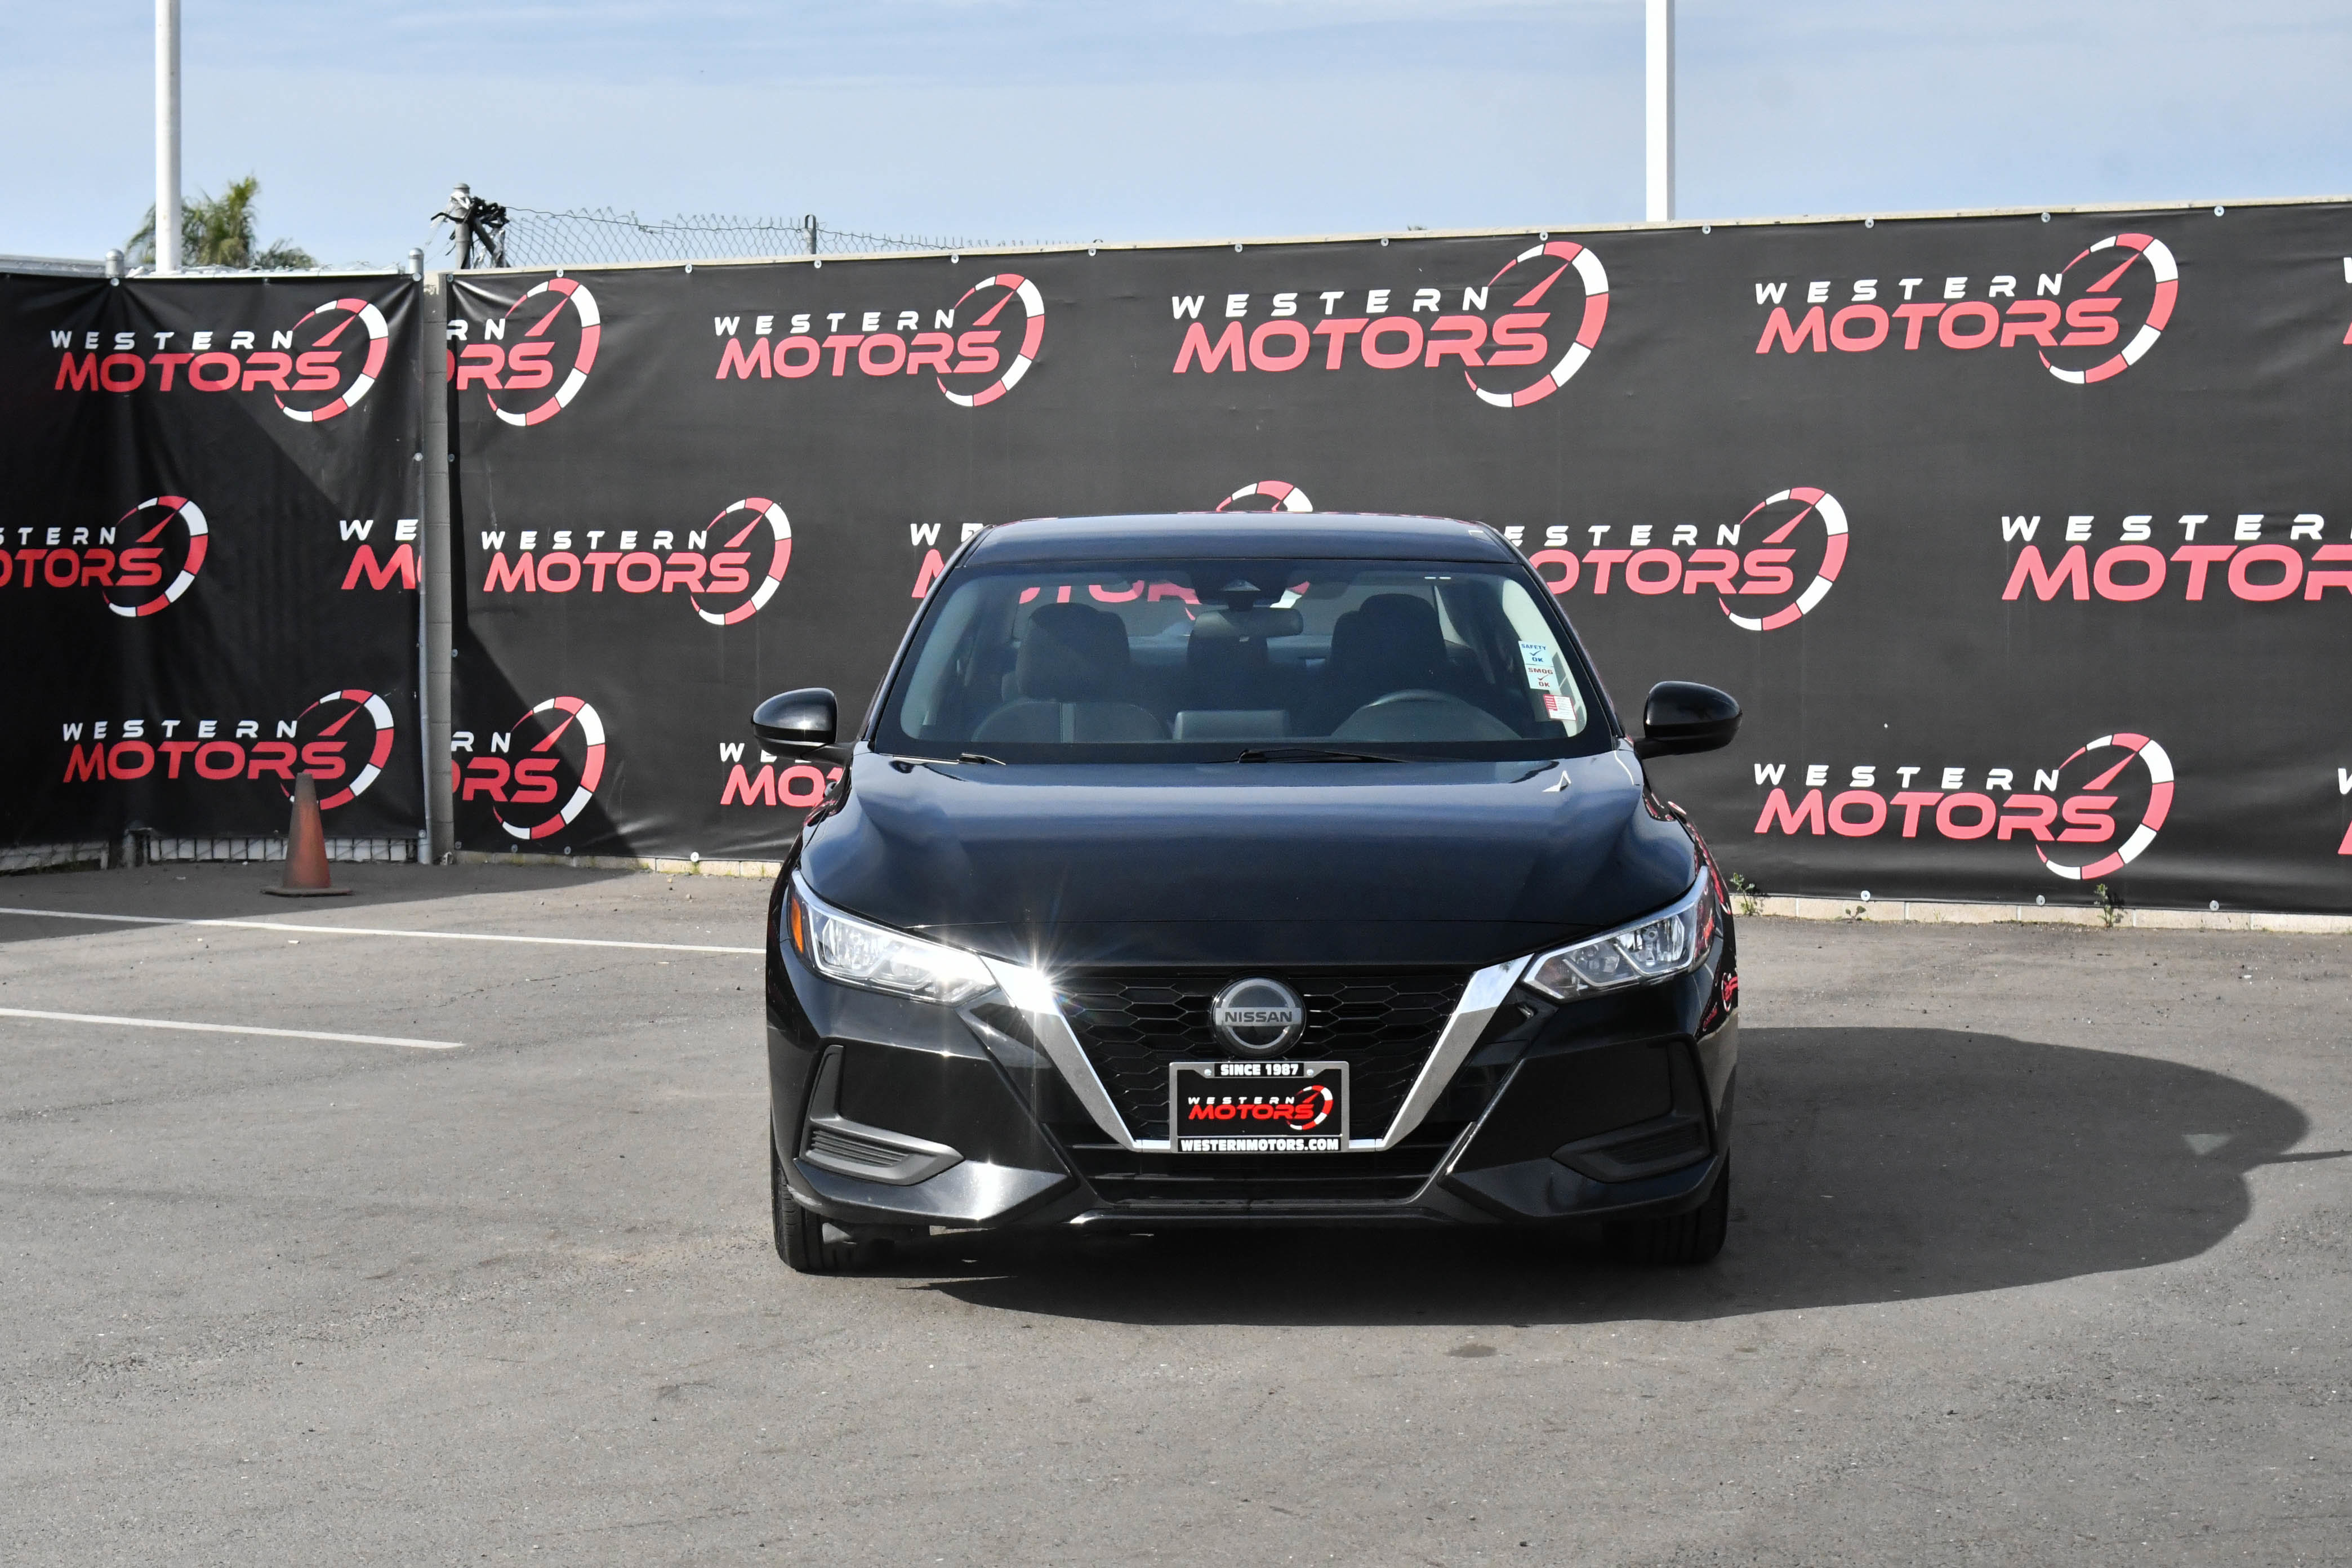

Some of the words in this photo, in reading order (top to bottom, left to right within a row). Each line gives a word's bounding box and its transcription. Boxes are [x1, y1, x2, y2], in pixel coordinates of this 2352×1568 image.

[1172, 284, 1489, 319] WESTERN
[1756, 273, 2063, 305] WESTERN
[715, 307, 955, 336] WESTERN
[1756, 297, 2122, 354] MOTORS
[52, 331, 293, 350] WESTERN
[716, 330, 1001, 380] MOTORS
[1173, 312, 1550, 373] MOTORS
[55, 351, 342, 392] MOTORS
[447, 341, 555, 390] RS
[482, 529, 707, 550] WESTERN
[2002, 514, 2352, 542] WESTER
[341, 543, 421, 590] M
[483, 551, 751, 594] MOTORS
[64, 720, 297, 741] WESTERN
[63, 740, 347, 783] MOTORS
[1754, 764, 2059, 791] WESTERN
[452, 757, 560, 803] RS
[720, 764, 843, 808] MO
[1754, 787, 2118, 843] MOTORS
[1224, 1012, 1293, 1023] NISSAN
[1220, 1064, 1261, 1076] SINCE
[1266, 1064, 1299, 1076] 1987
[1188, 1104, 1315, 1120] MOTORS
[1181, 1139, 1339, 1151] WESTERNMOTORS.COM
